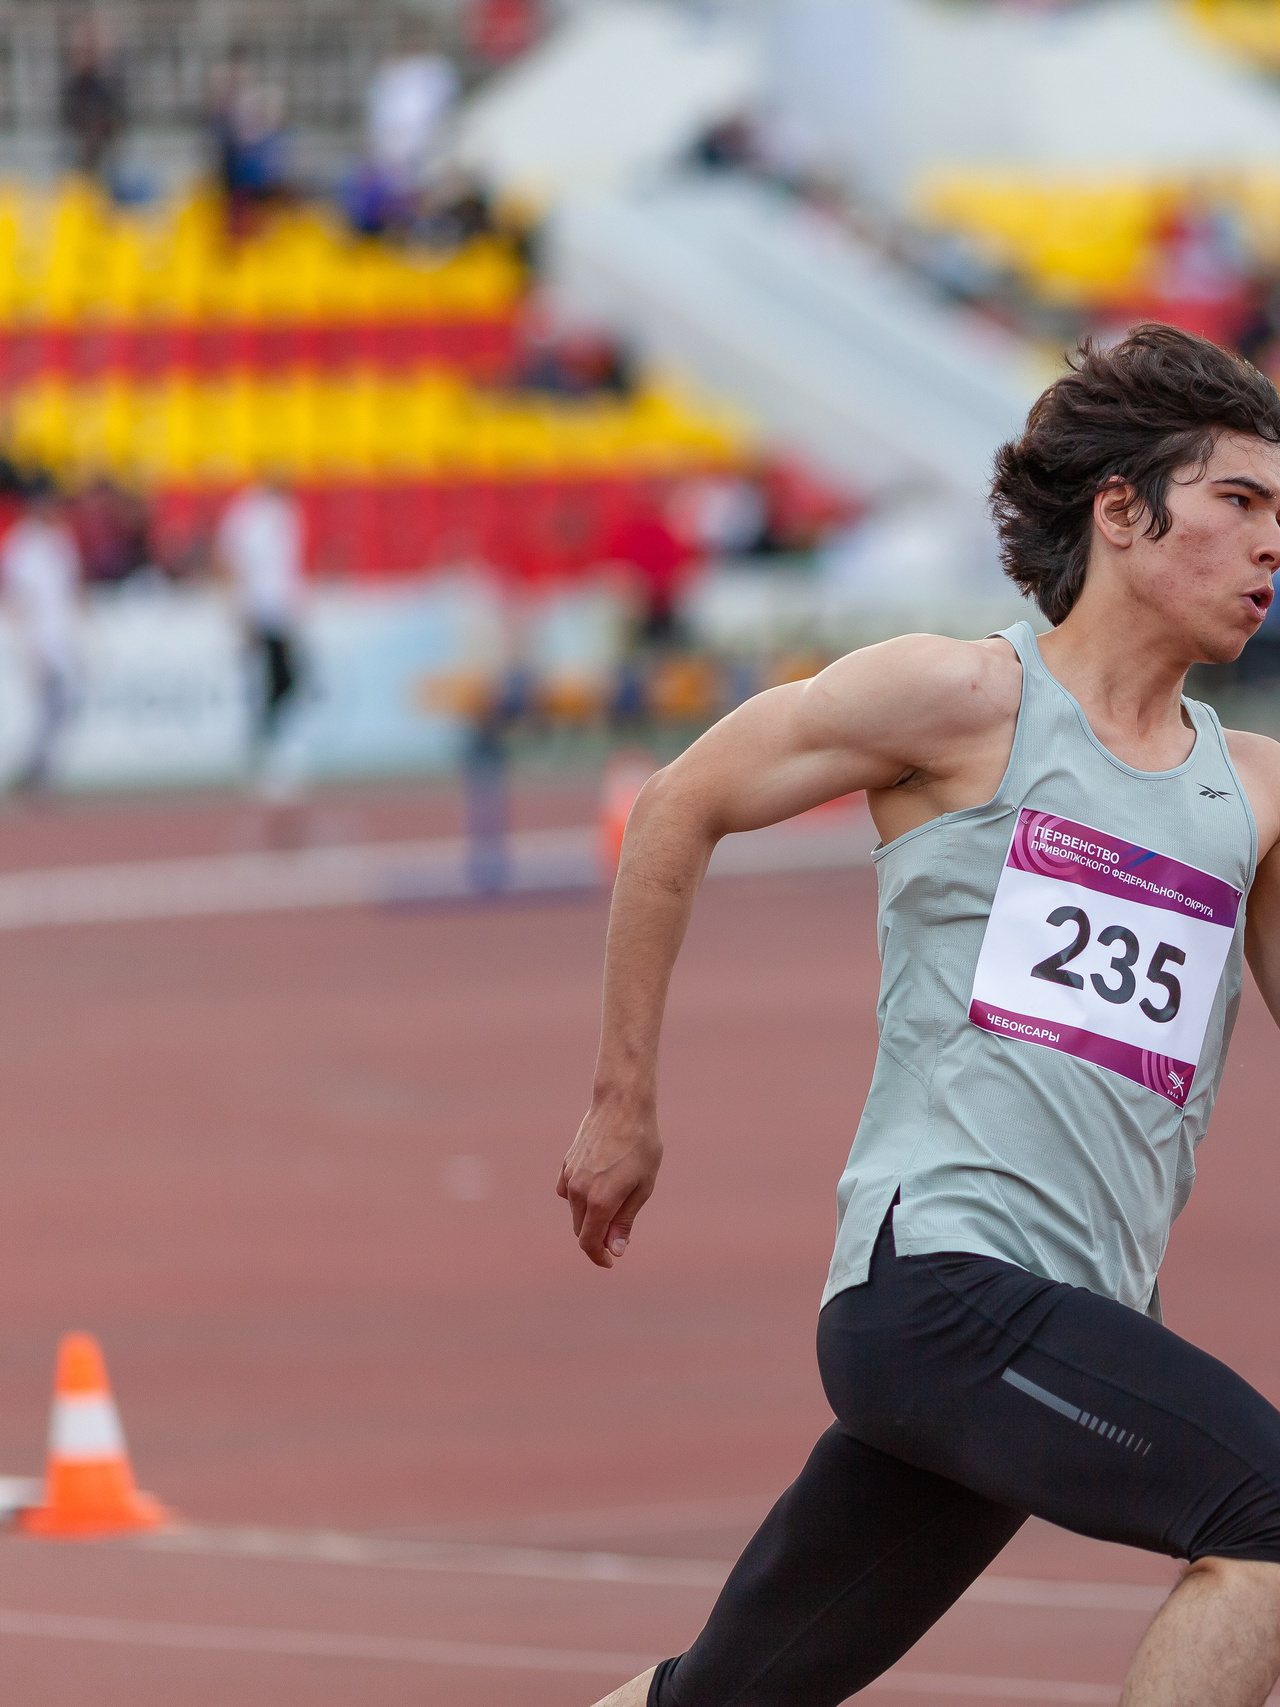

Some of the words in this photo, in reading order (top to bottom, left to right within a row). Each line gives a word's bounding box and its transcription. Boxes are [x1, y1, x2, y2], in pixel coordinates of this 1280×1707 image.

[1034, 825, 1120, 865] ПЕРВЕНСТВО
[1030, 840, 1111, 874] ПРИВОЛЖСКОГО
[1111, 868, 1184, 903] ФЕДЕРАЛЬНОГО
[1184, 897, 1214, 918] ОКРУГА
[1030, 905, 1187, 1024] 235
[986, 1012, 1061, 1043] ЧЕБОКСАРЫ
